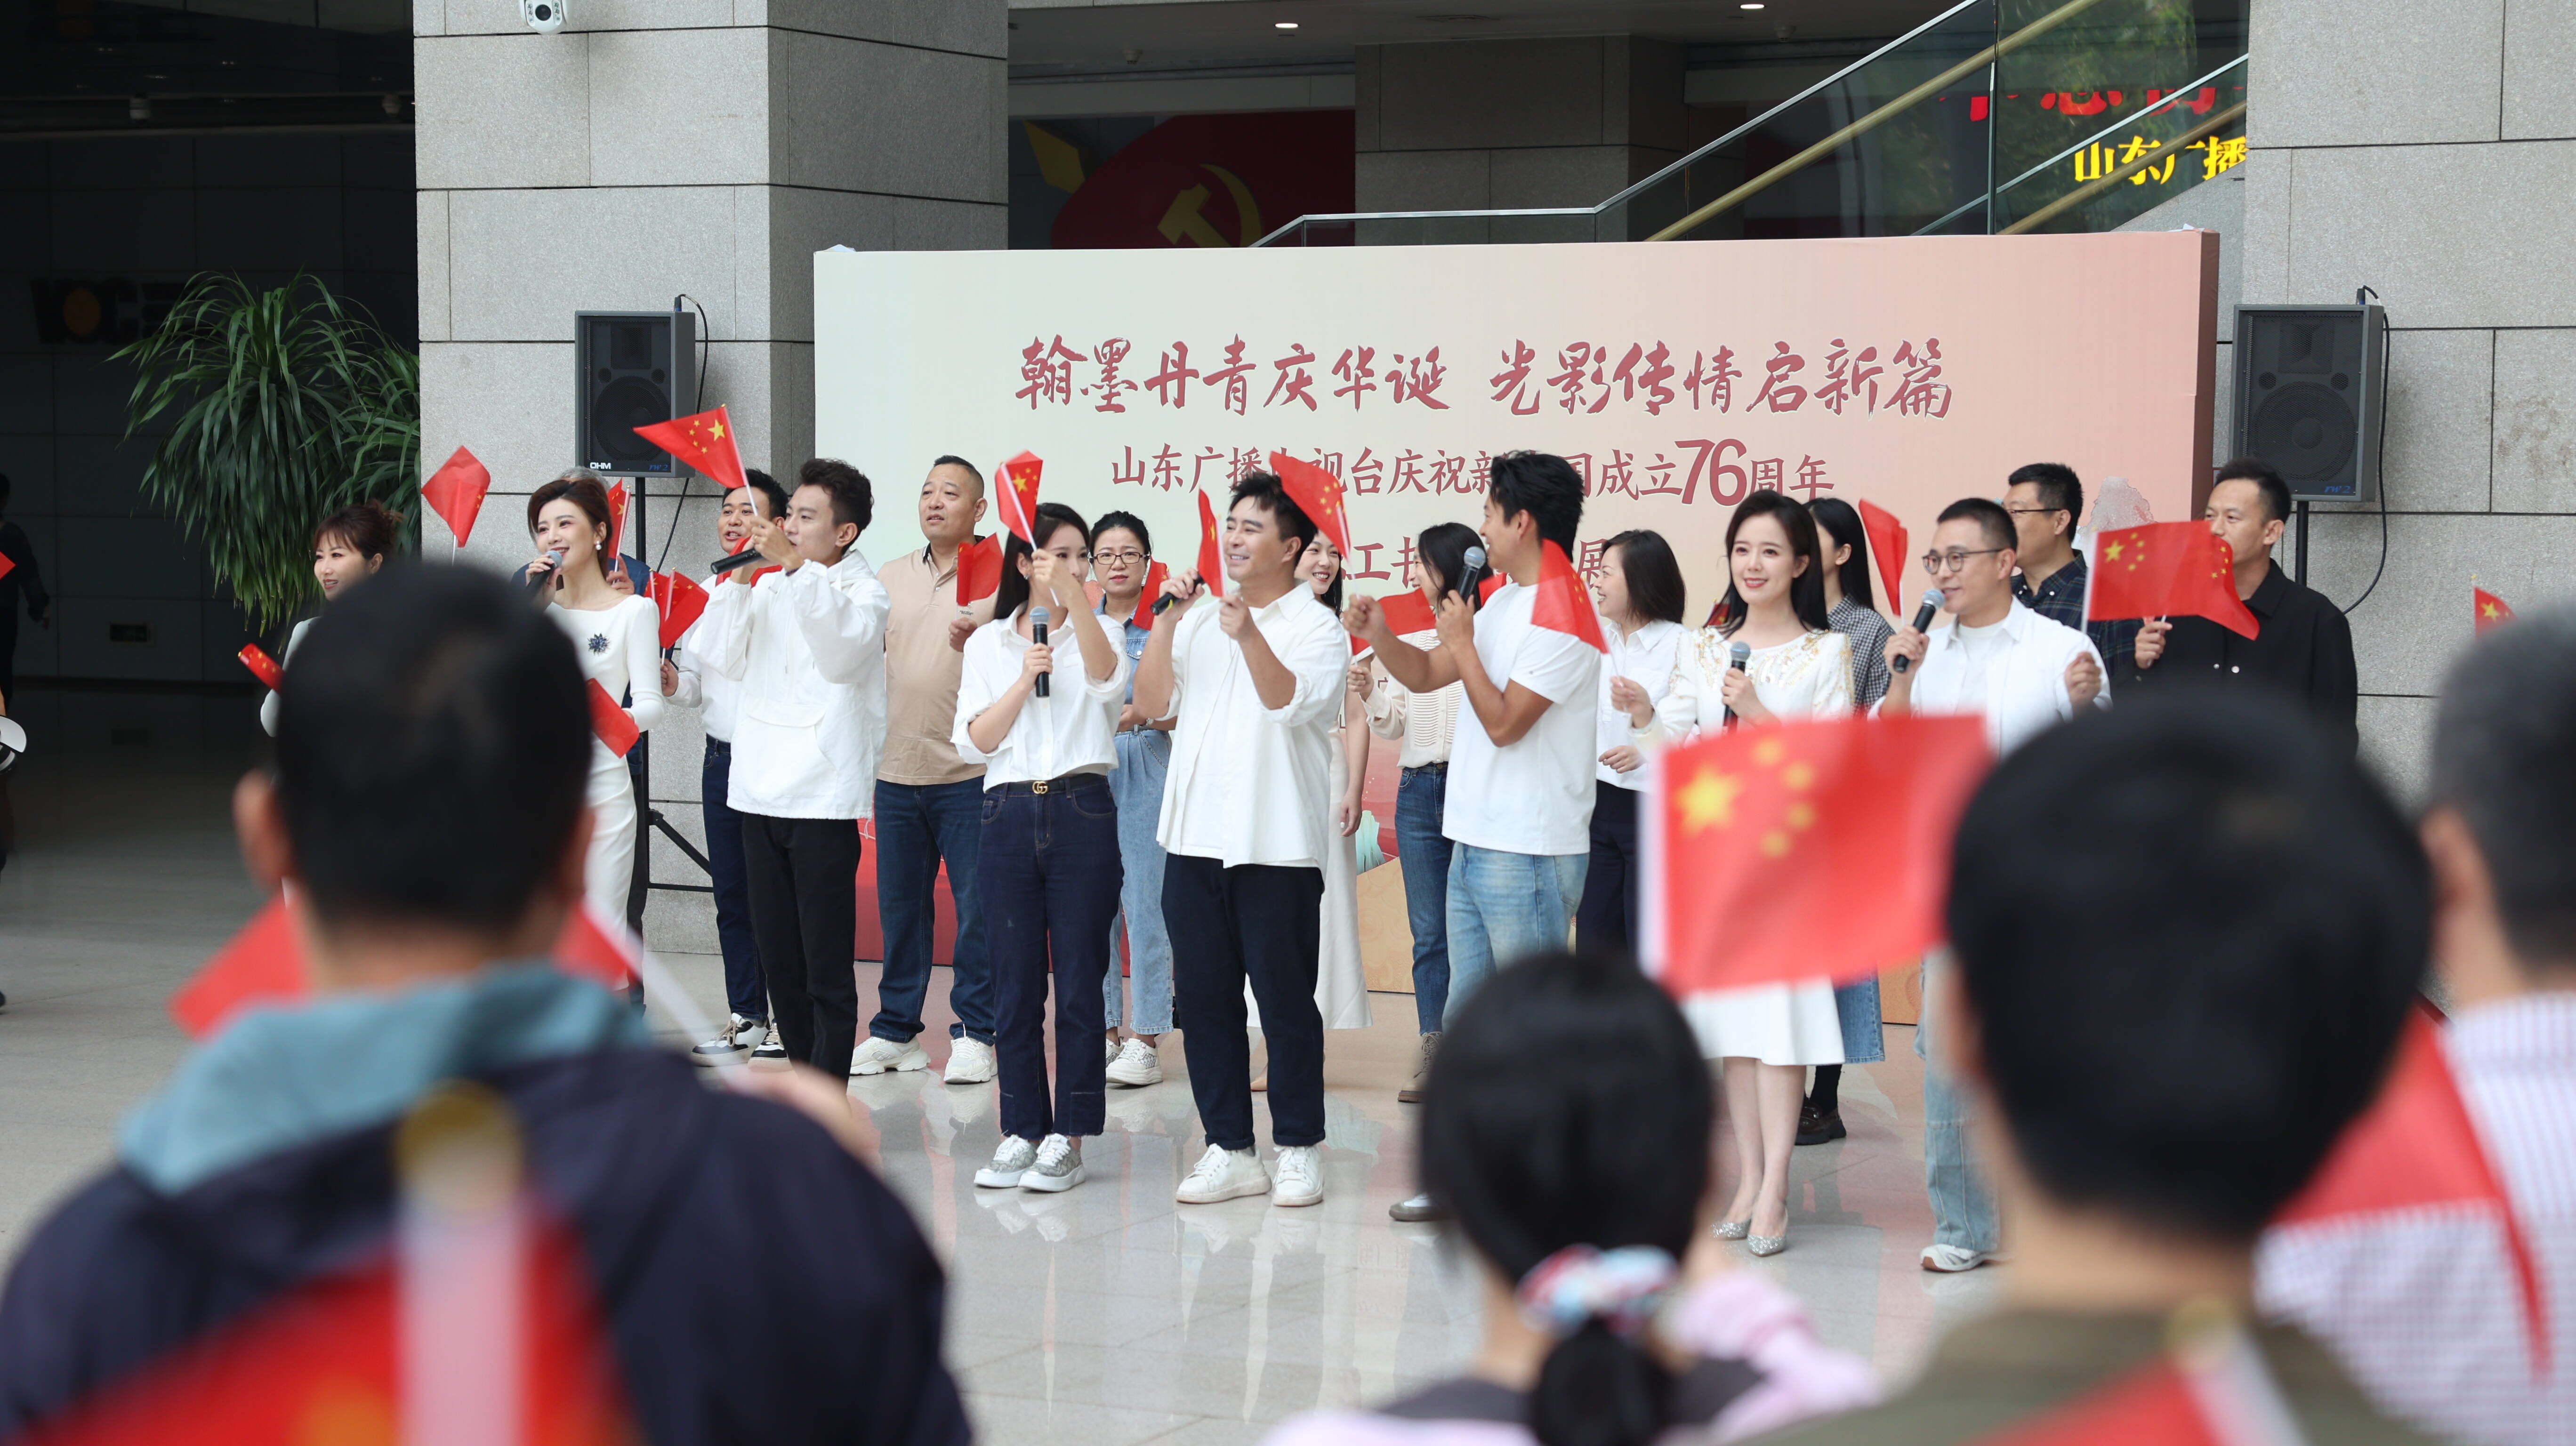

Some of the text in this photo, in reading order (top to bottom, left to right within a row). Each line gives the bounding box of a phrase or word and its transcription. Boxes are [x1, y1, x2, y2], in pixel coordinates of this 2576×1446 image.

[1015, 333, 1952, 420] 翰墨丹青庆华诞 光影传情启新篇
